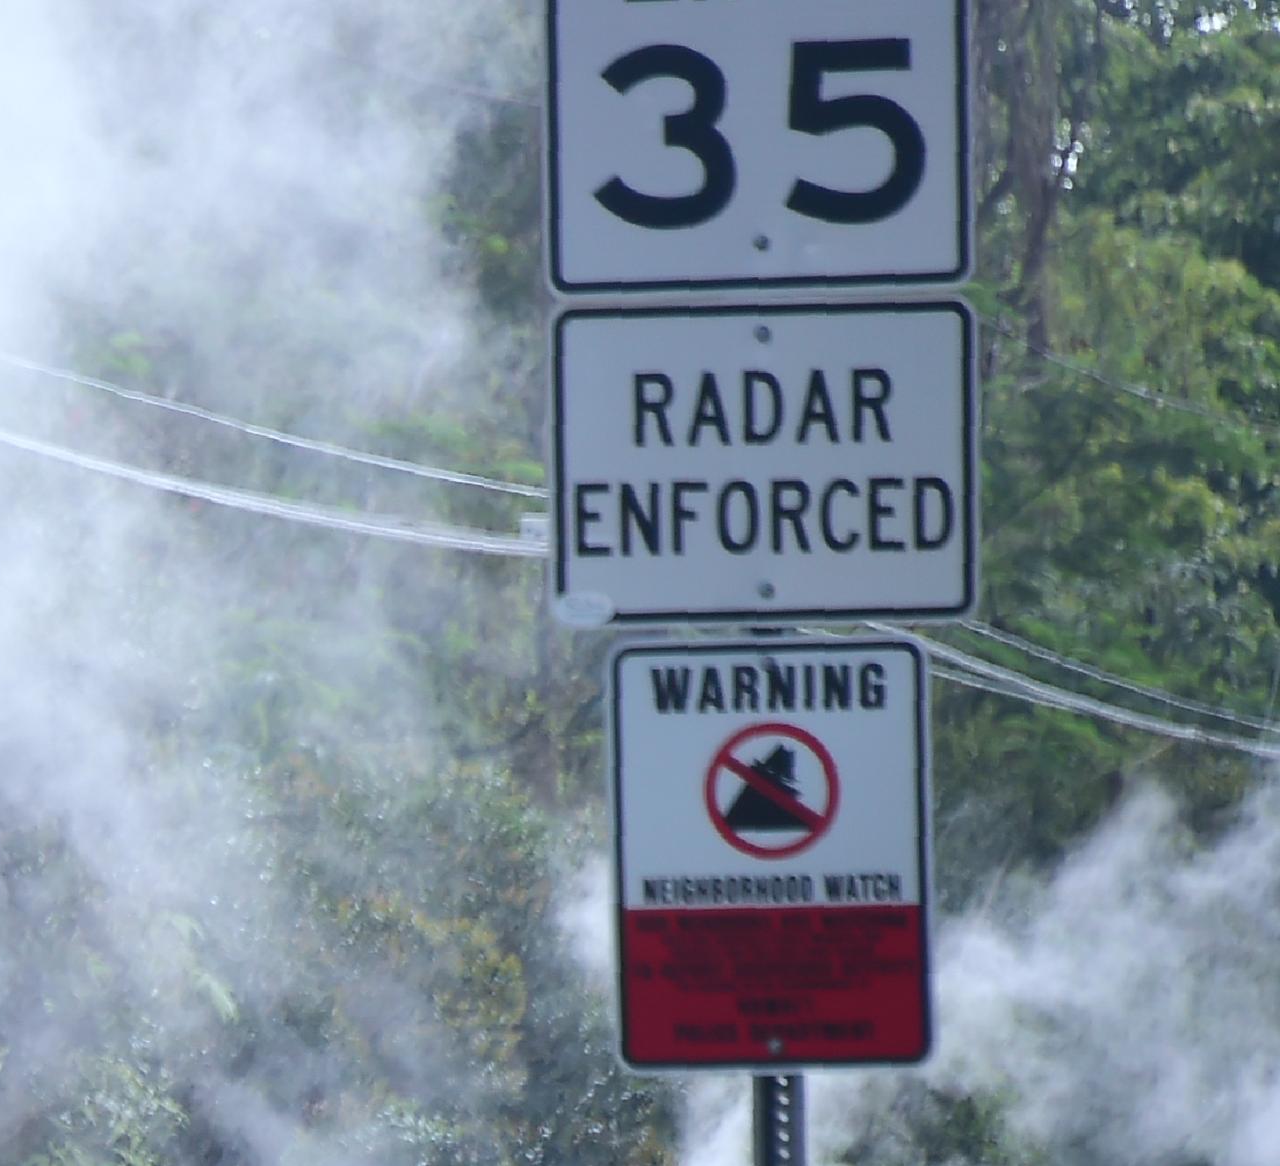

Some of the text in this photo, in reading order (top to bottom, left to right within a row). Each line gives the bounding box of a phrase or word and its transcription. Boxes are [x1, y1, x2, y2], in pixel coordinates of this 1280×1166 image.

[594, 38, 926, 229] 35
[633, 368, 892, 447] RADAR
[575, 476, 954, 557] ENFORCED
[651, 663, 888, 714] WARNING
[644, 873, 903, 905] NEIGHBORHOOD WATCH
